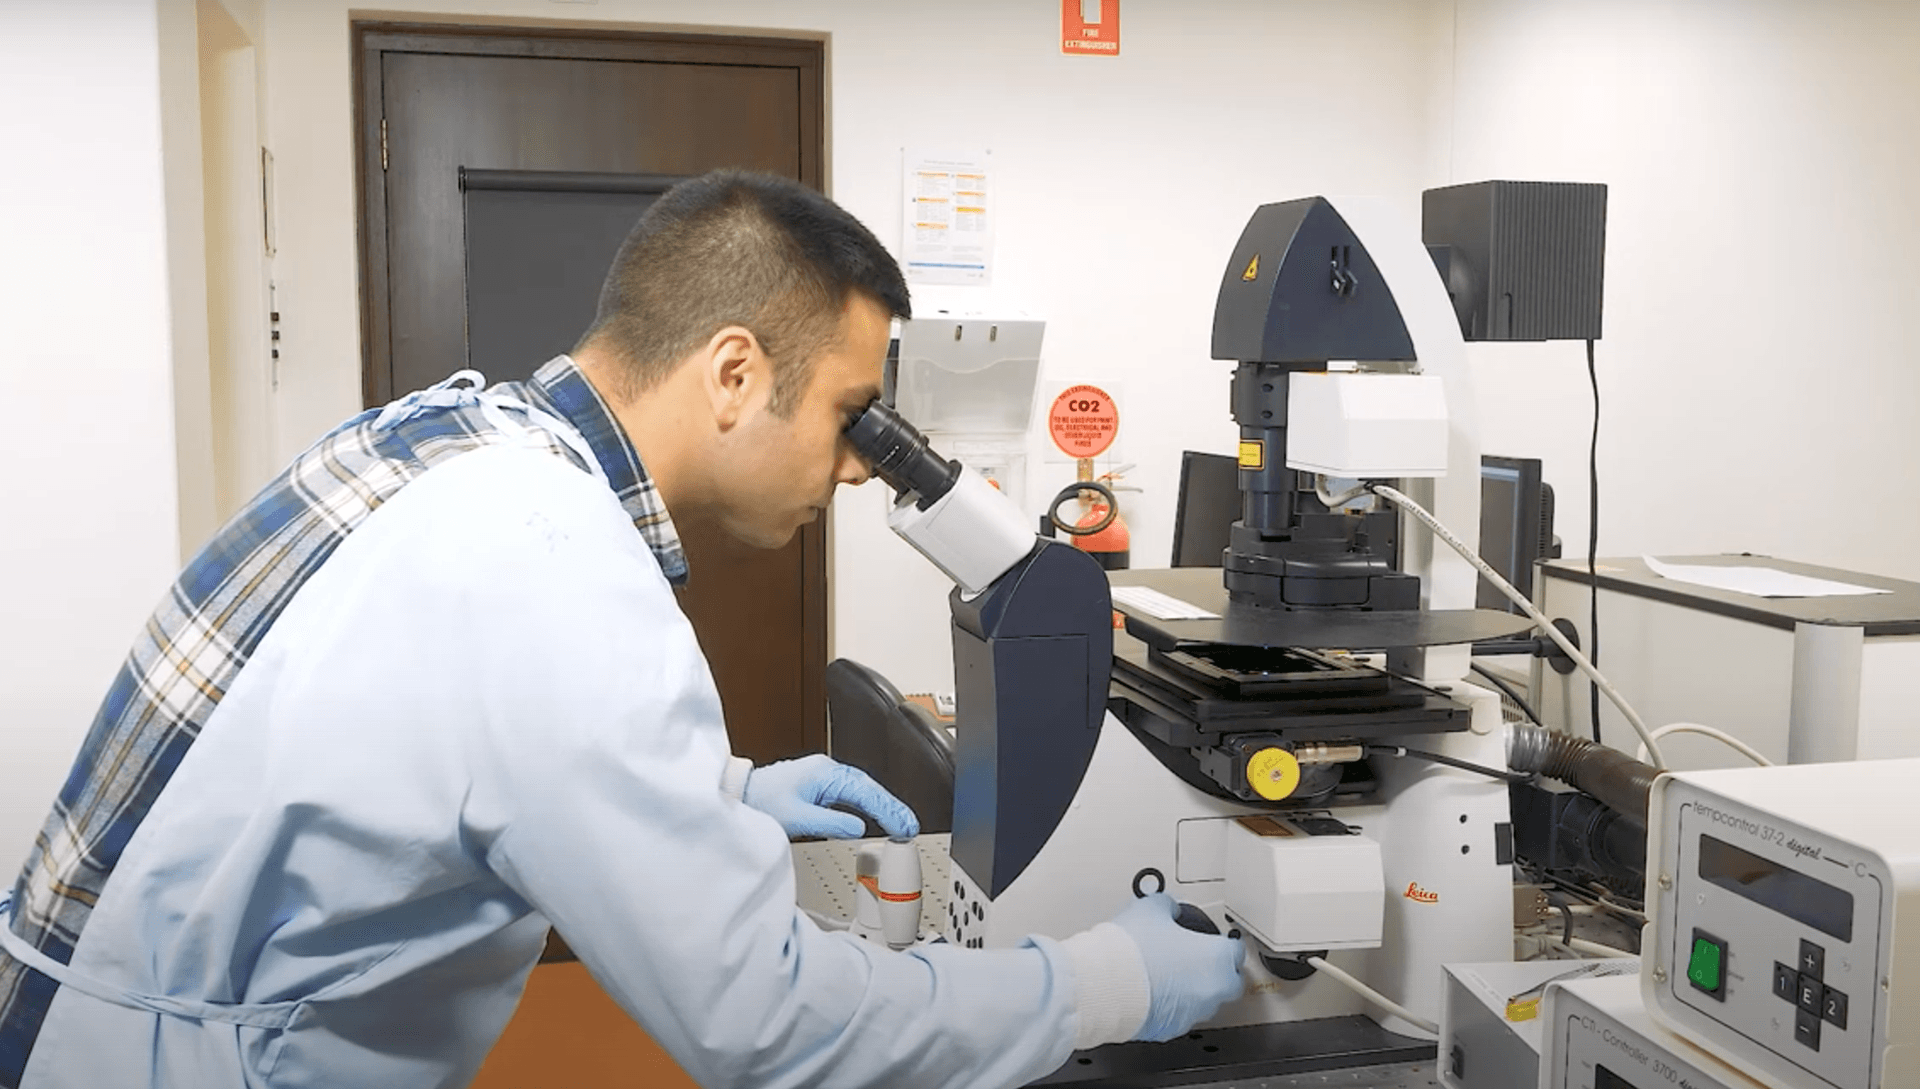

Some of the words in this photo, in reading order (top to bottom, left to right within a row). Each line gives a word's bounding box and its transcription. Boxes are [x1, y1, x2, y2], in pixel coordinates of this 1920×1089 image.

[1082, 29, 1099, 37] FIRE
[1065, 40, 1117, 50] EXTINGUISHER
[1069, 399, 1100, 412] CO2
[1693, 800, 1759, 836] tempcontrol
[1760, 826, 1785, 846] 37-2
[1786, 838, 1822, 859] digital
[1403, 881, 1439, 903] Leica
[1803, 988, 1811, 1004] E
[1828, 1001, 1835, 1015] 2
[1602, 1029, 1649, 1065] Controller
[1652, 1059, 1677, 1083] 3700
